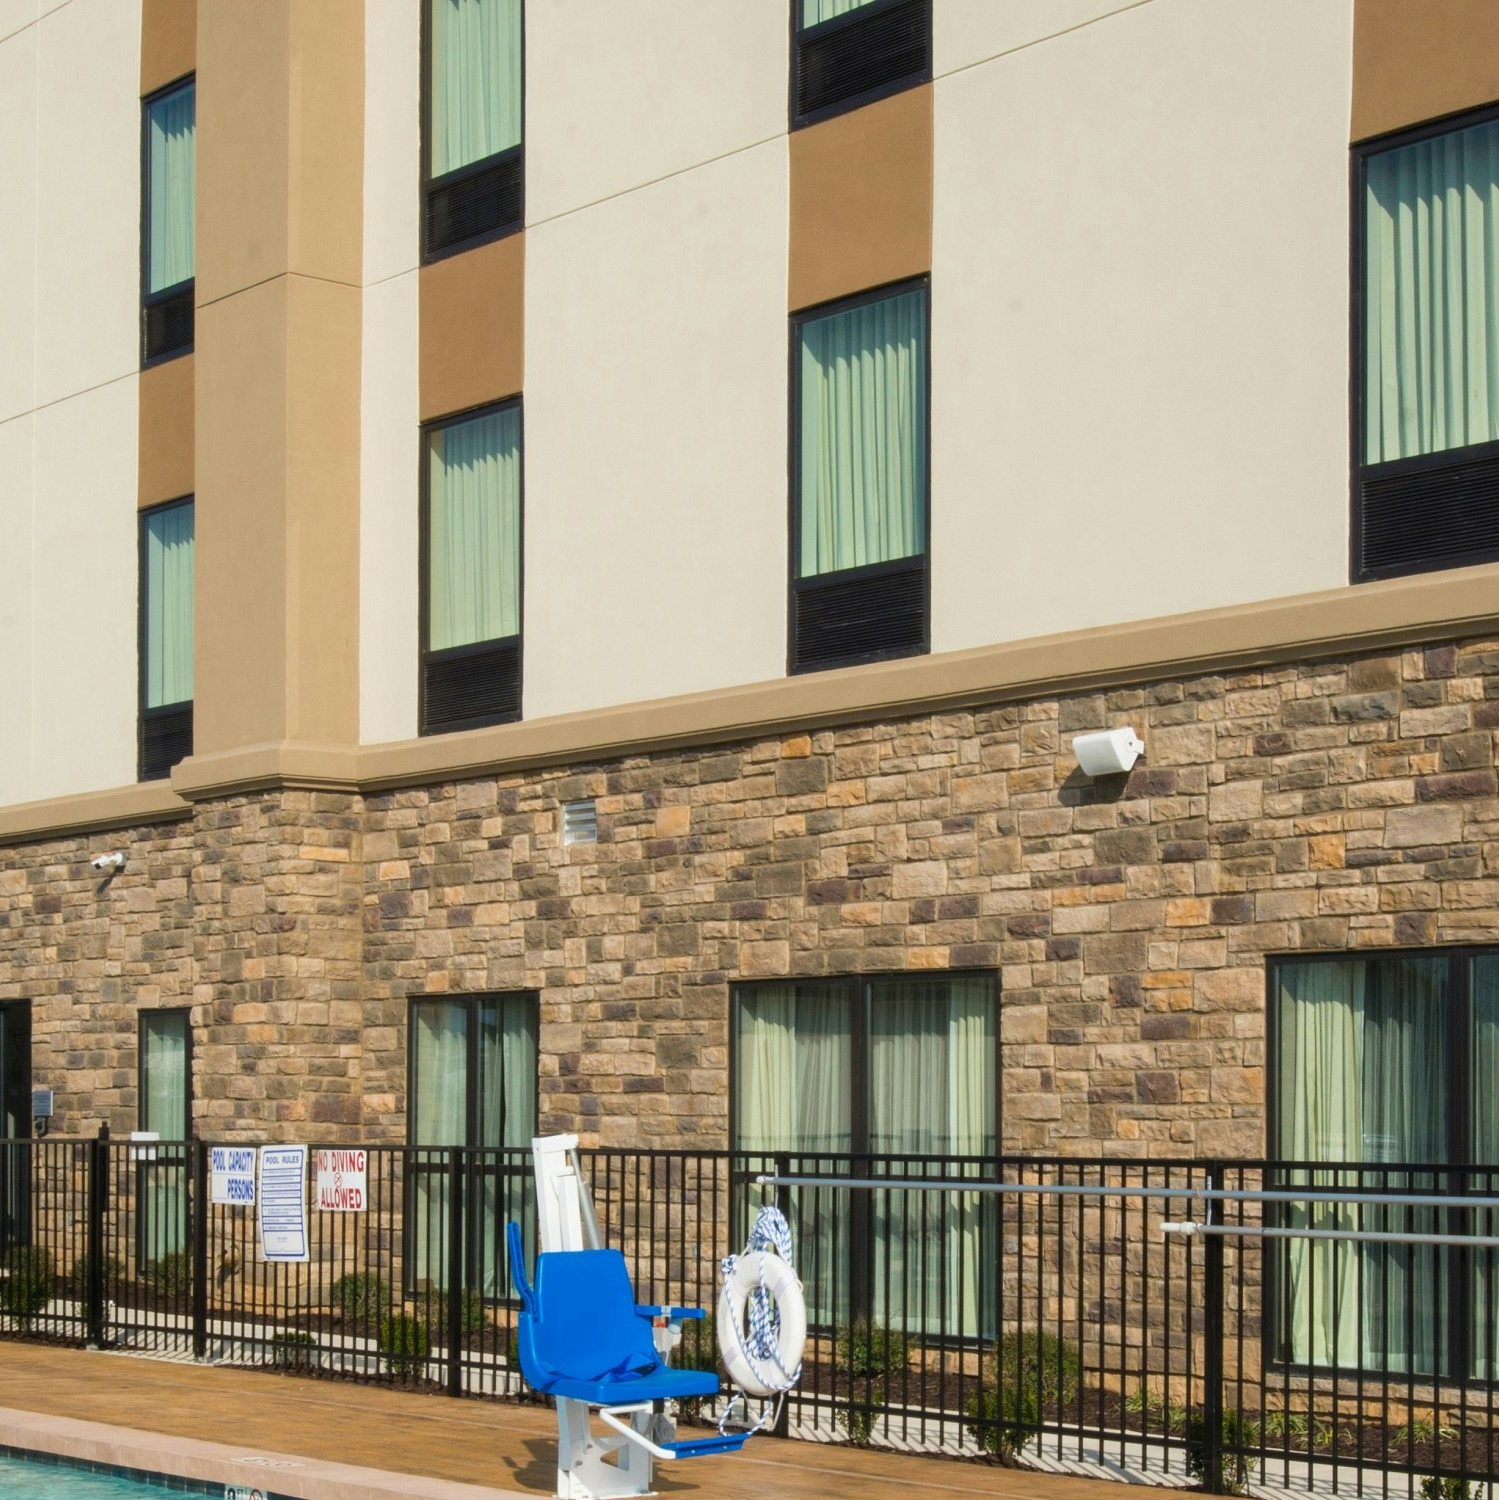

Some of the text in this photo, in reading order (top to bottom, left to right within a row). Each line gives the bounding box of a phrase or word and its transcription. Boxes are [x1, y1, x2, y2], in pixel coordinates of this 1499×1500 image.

[213, 1151, 253, 1171] POOL CAPACITY
[318, 1151, 364, 1173] NO DIVING
[228, 1180, 253, 1200] PERSONS
[321, 1188, 361, 1208] ALLOWED
